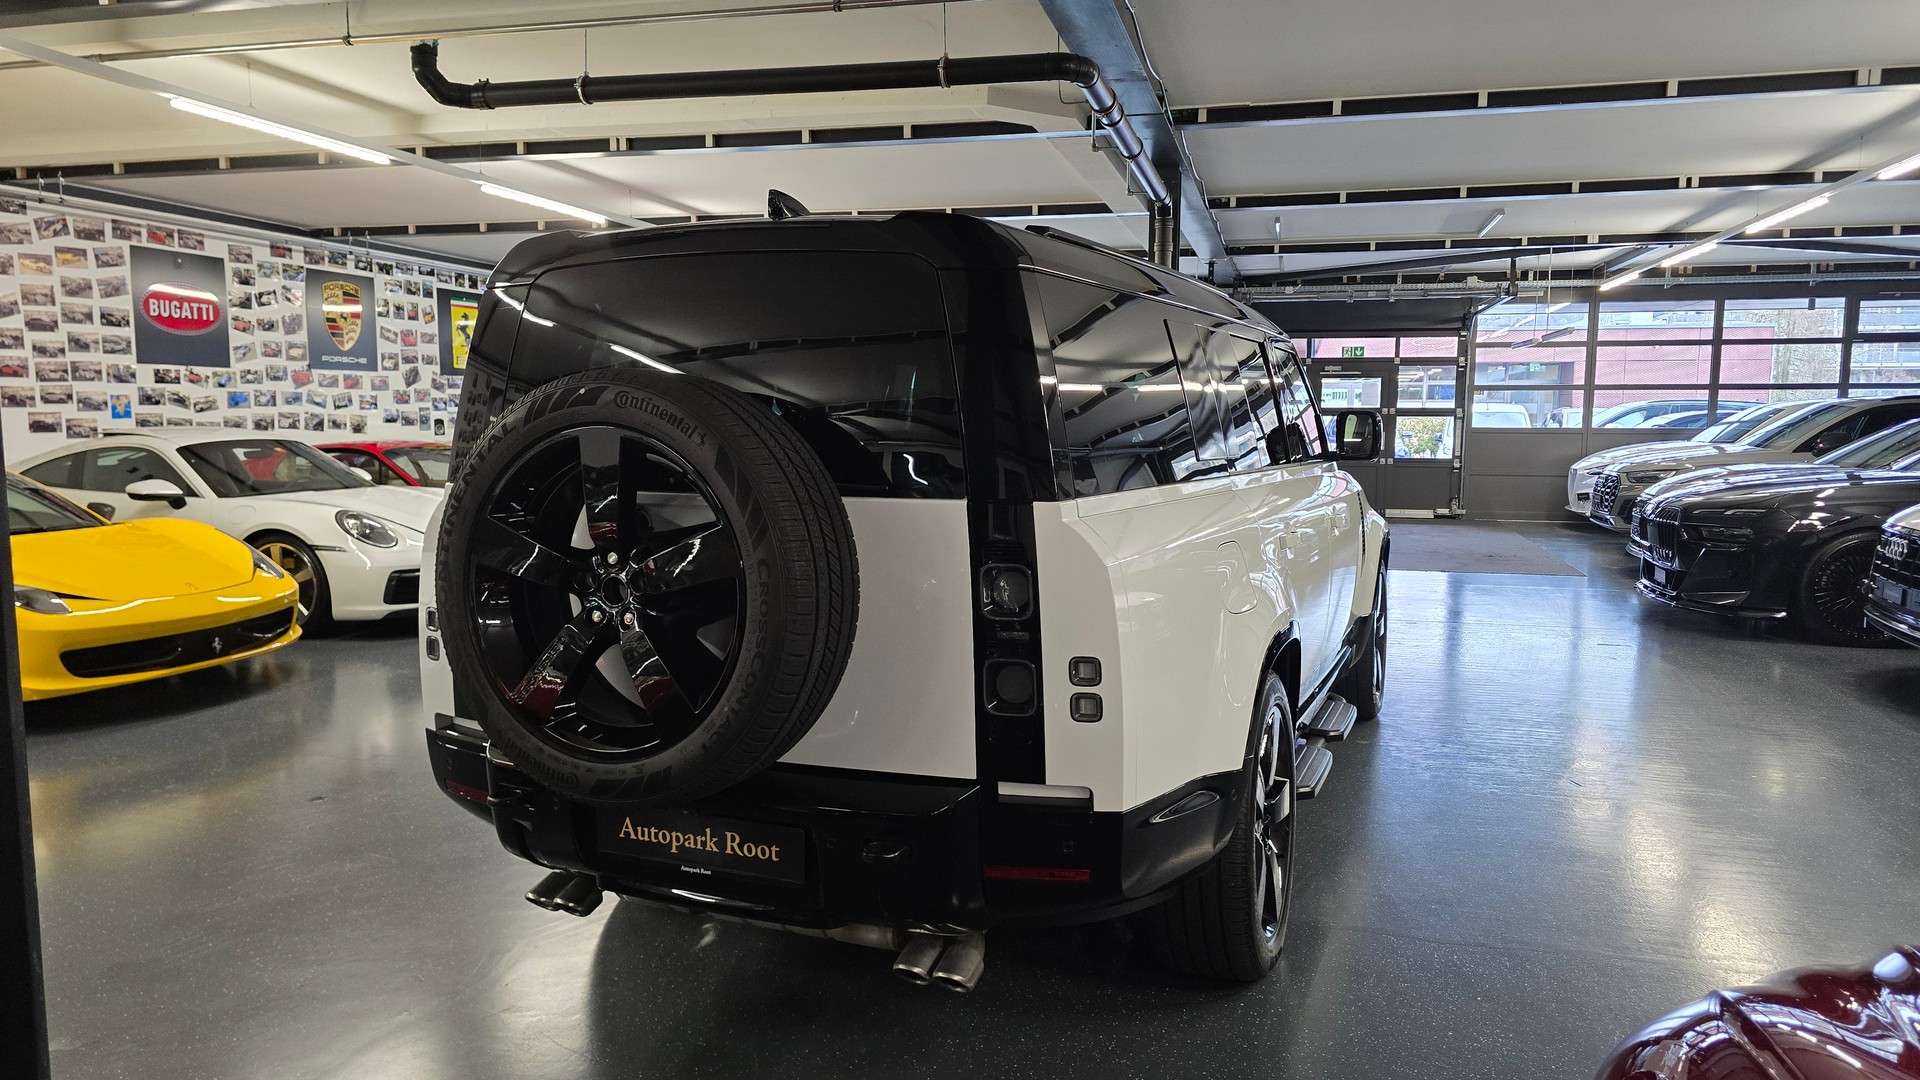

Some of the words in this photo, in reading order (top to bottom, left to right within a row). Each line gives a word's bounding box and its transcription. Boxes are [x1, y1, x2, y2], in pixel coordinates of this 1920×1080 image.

[148, 298, 214, 321] BUGATTI
[321, 355, 368, 364] PORSCHE
[613, 390, 699, 440] Continental
[618, 816, 720, 853] Autopark
[725, 831, 780, 862] Root
